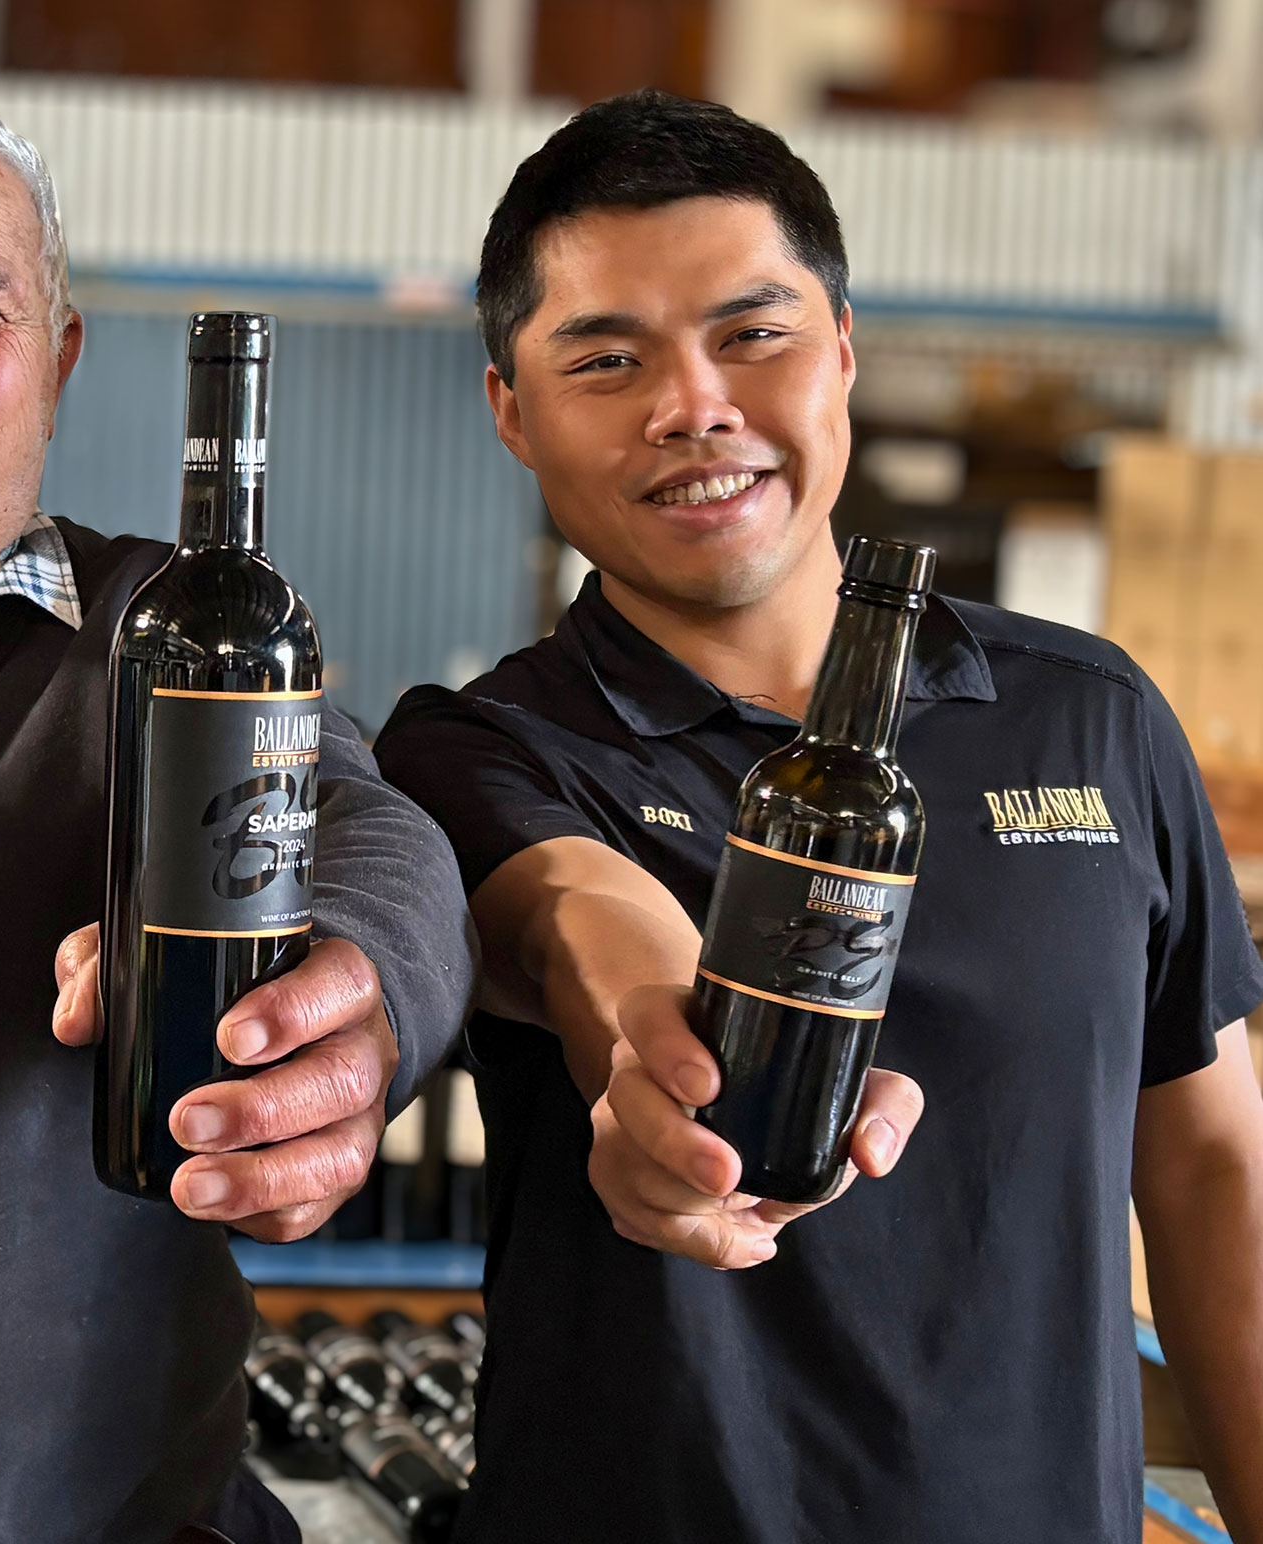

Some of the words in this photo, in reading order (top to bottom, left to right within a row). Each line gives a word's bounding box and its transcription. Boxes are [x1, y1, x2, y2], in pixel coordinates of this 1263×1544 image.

[252, 755, 300, 768] ESTATE
[984, 786, 1113, 828] BALLANDEAN
[640, 805, 694, 832] BOXI
[282, 839, 305, 853] 2024
[999, 830, 1068, 846] ESTATE
[1075, 829, 1120, 846] WINES
[808, 875, 888, 910] BALLANDEAN
